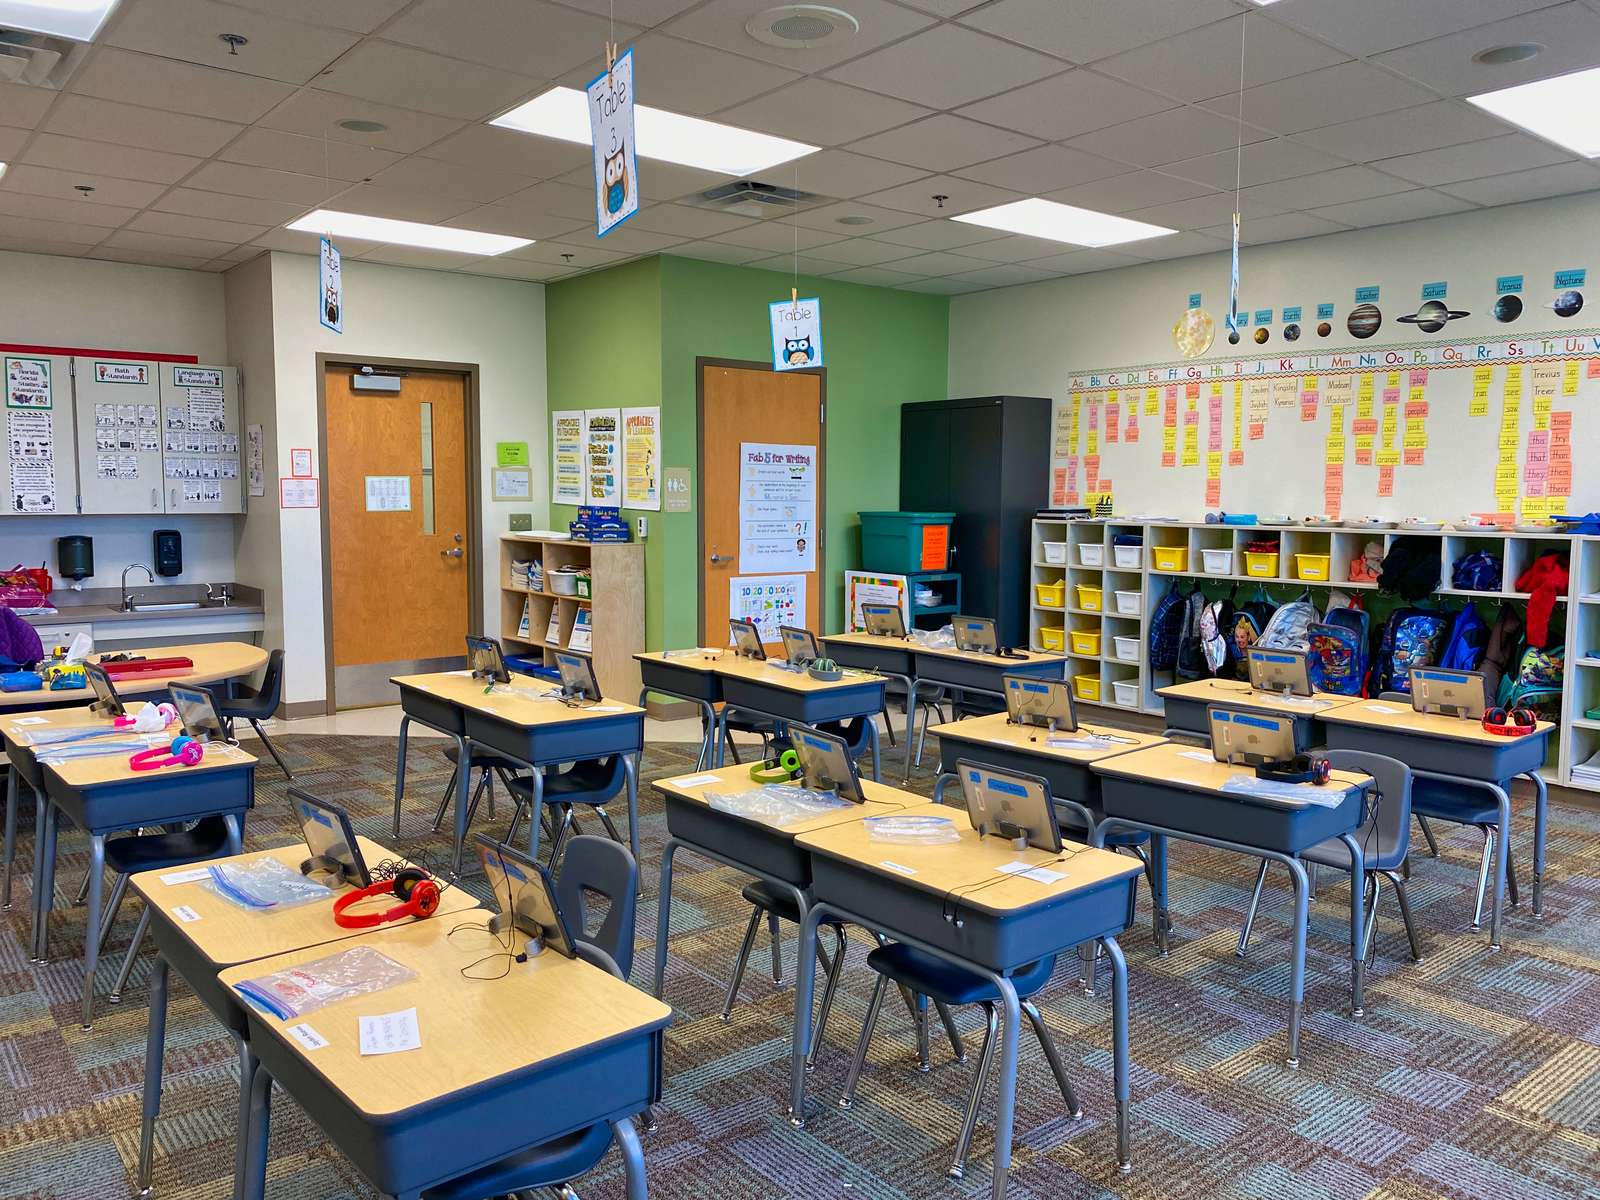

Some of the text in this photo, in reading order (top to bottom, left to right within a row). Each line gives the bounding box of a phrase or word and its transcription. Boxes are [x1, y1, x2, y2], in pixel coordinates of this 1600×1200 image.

[597, 82, 627, 123] Table
[610, 127, 618, 153] 3
[1556, 275, 1585, 287] Neptune
[1497, 282, 1522, 293] Uranus
[1423, 288, 1447, 298] Saturn
[778, 308, 812, 322] Table
[1283, 308, 1300, 321] Earth
[1072, 379, 1084, 388] Aa
[1090, 376, 1101, 387] Bb
[1108, 375, 1120, 385] Cc
[1127, 373, 1140, 383] Dd
[1148, 370, 1159, 381] Ee
[1168, 368, 1178, 379] Ff
[1187, 367, 1202, 380] Gg
[1211, 365, 1223, 376] Hh
[1234, 363, 1243, 374] Ii
[1256, 361, 1265, 374] Jj
[1280, 359, 1293, 371] Kk
[1309, 357, 1319, 369] Ll
[1331, 356, 1352, 368] Mm
[1360, 354, 1377, 366] Nn
[1385, 352, 1404, 364] Oo
[1414, 350, 1428, 363] Pp
[1442, 348, 1463, 361] Qq
[1477, 345, 1492, 358] Rr
[1508, 343, 1524, 356] Ss
[1541, 340, 1554, 353] Tt
[1566, 338, 1585, 351] Uu
[106, 373, 138, 381] Standards
[1476, 370, 1490, 380] read
[1533, 368, 1560, 378] Trevius
[1412, 375, 1425, 385] play
[13, 387, 45, 395] Standards
[1408, 406, 1426, 416] people
[1473, 404, 1485, 413] red
[1536, 402, 1549, 411] the
[748, 452, 764, 463] Fab
[772, 453, 784, 463] for
[785, 454, 811, 466] Writing
[1378, 456, 1399, 464] orange
[1406, 452, 1421, 462] part
[1502, 453, 1513, 462] sat
[1530, 452, 1546, 461] that
[1528, 469, 1545, 480] they
[1552, 467, 1568, 476] them
[1380, 484, 1390, 493] off
[1550, 484, 1568, 493] there
[1525, 503, 1543, 511] then
[1550, 503, 1564, 511] two
[742, 587, 751, 596] 10
[752, 587, 762, 596] 20
